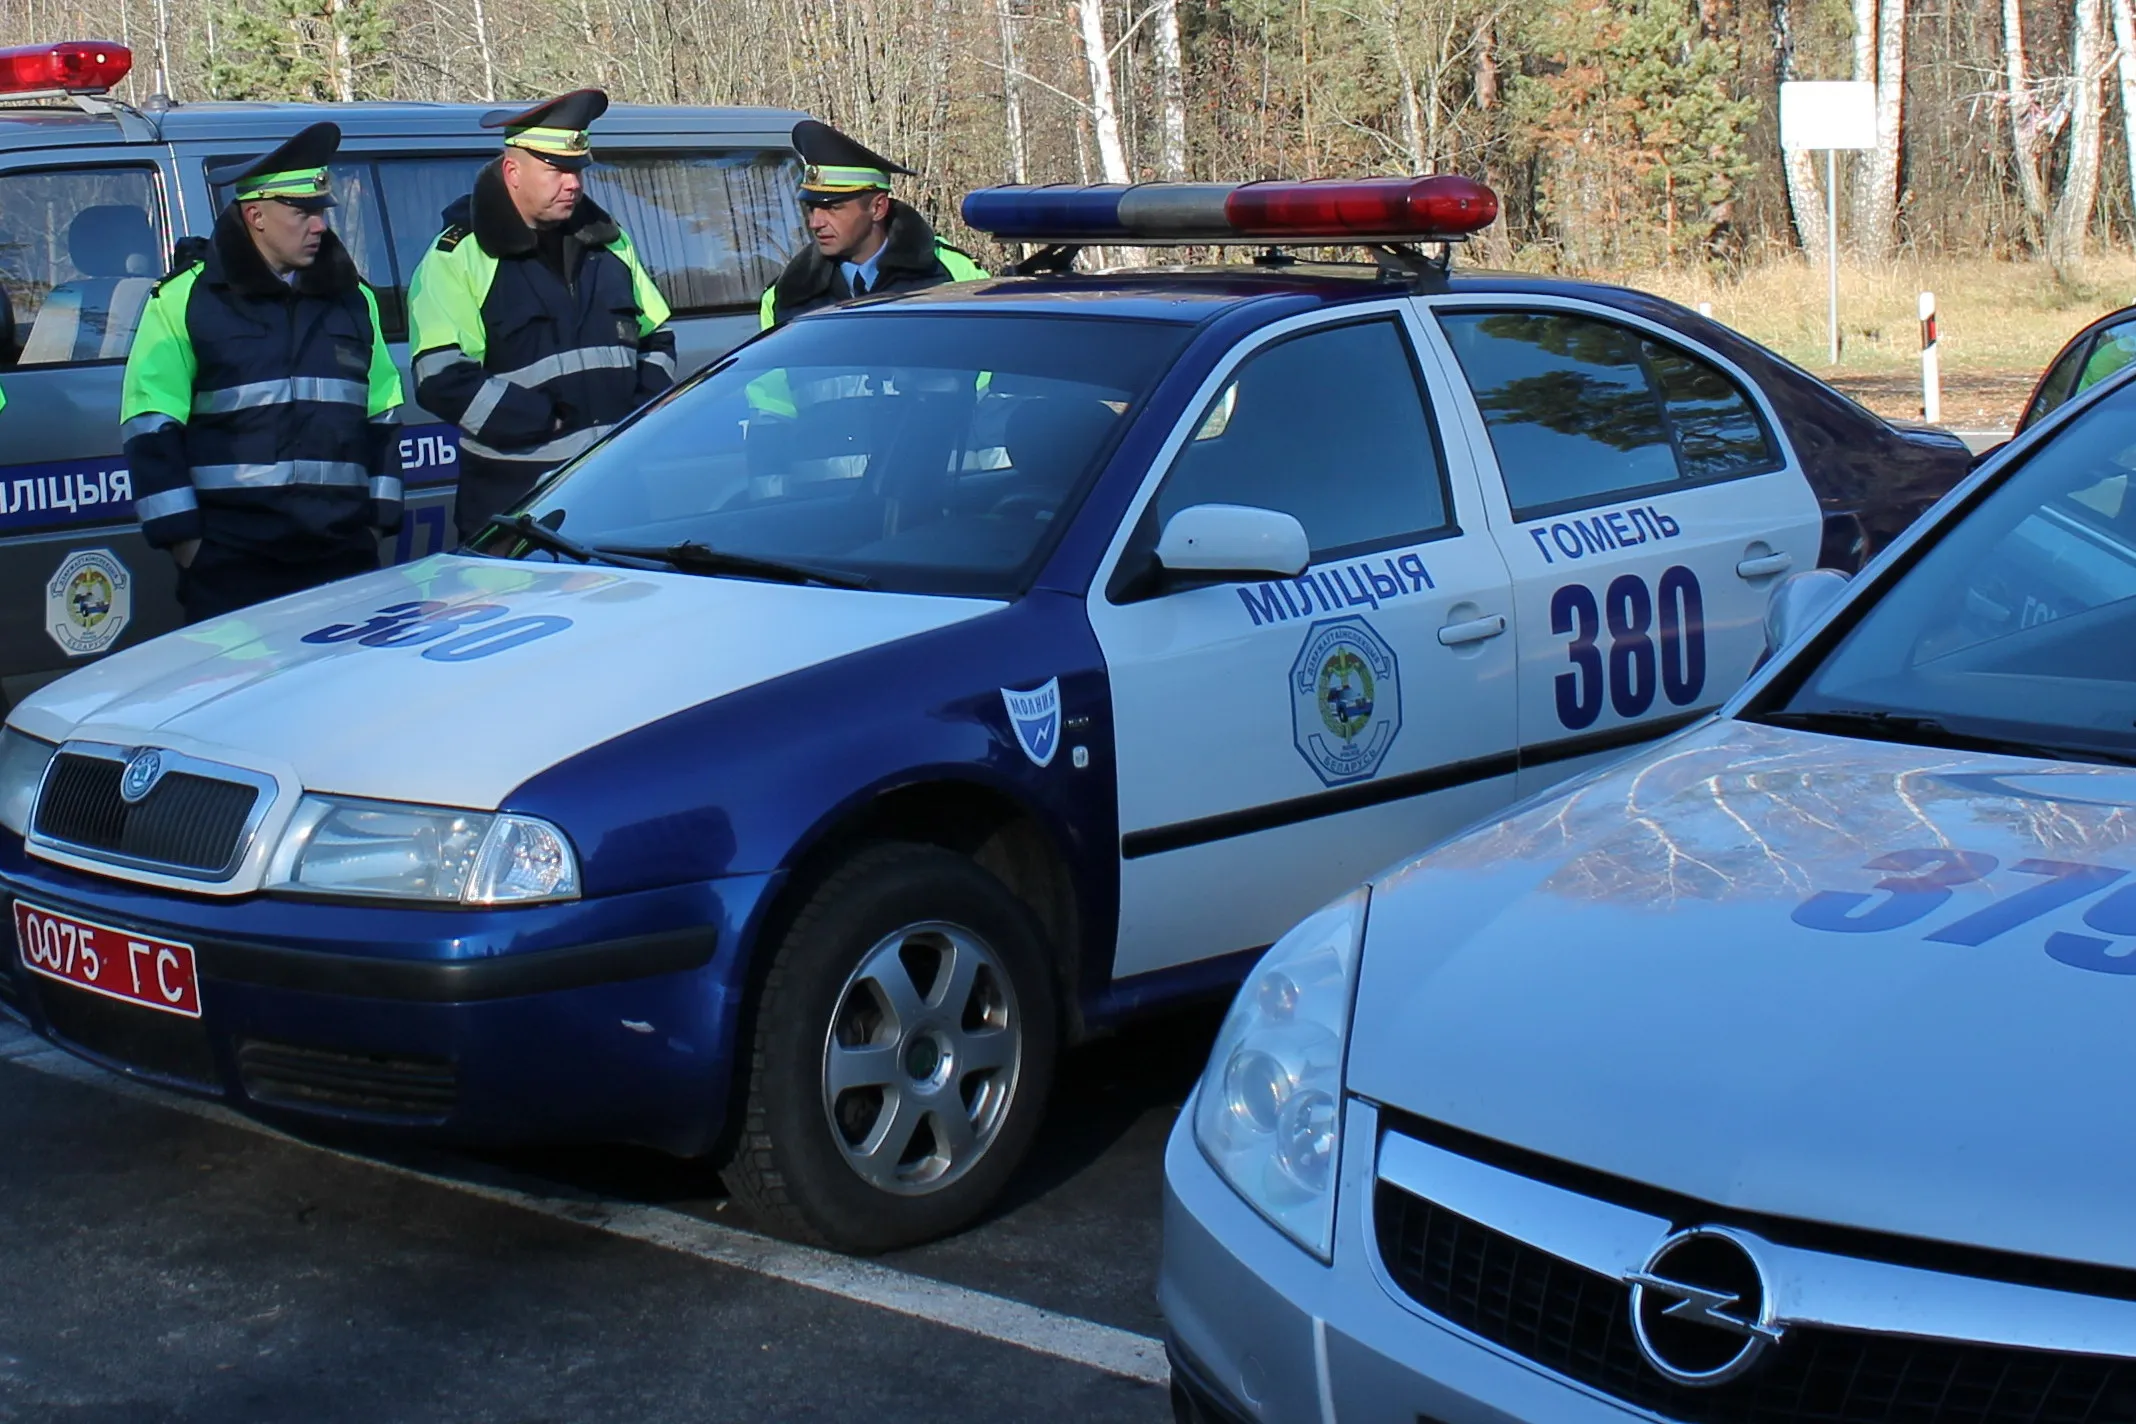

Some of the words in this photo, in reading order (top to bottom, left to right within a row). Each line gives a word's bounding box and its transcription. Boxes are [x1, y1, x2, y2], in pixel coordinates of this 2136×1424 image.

[1529, 506, 1681, 563] ГОМЕЛЬ
[1237, 554, 1435, 626] МІЛІЦЫЯ
[300, 601, 574, 662] 380
[1551, 565, 1706, 730] 380
[1009, 688, 1056, 716] МОЛНИЯ
[27, 912, 99, 981] 0075
[128, 941, 183, 1002] ГС
